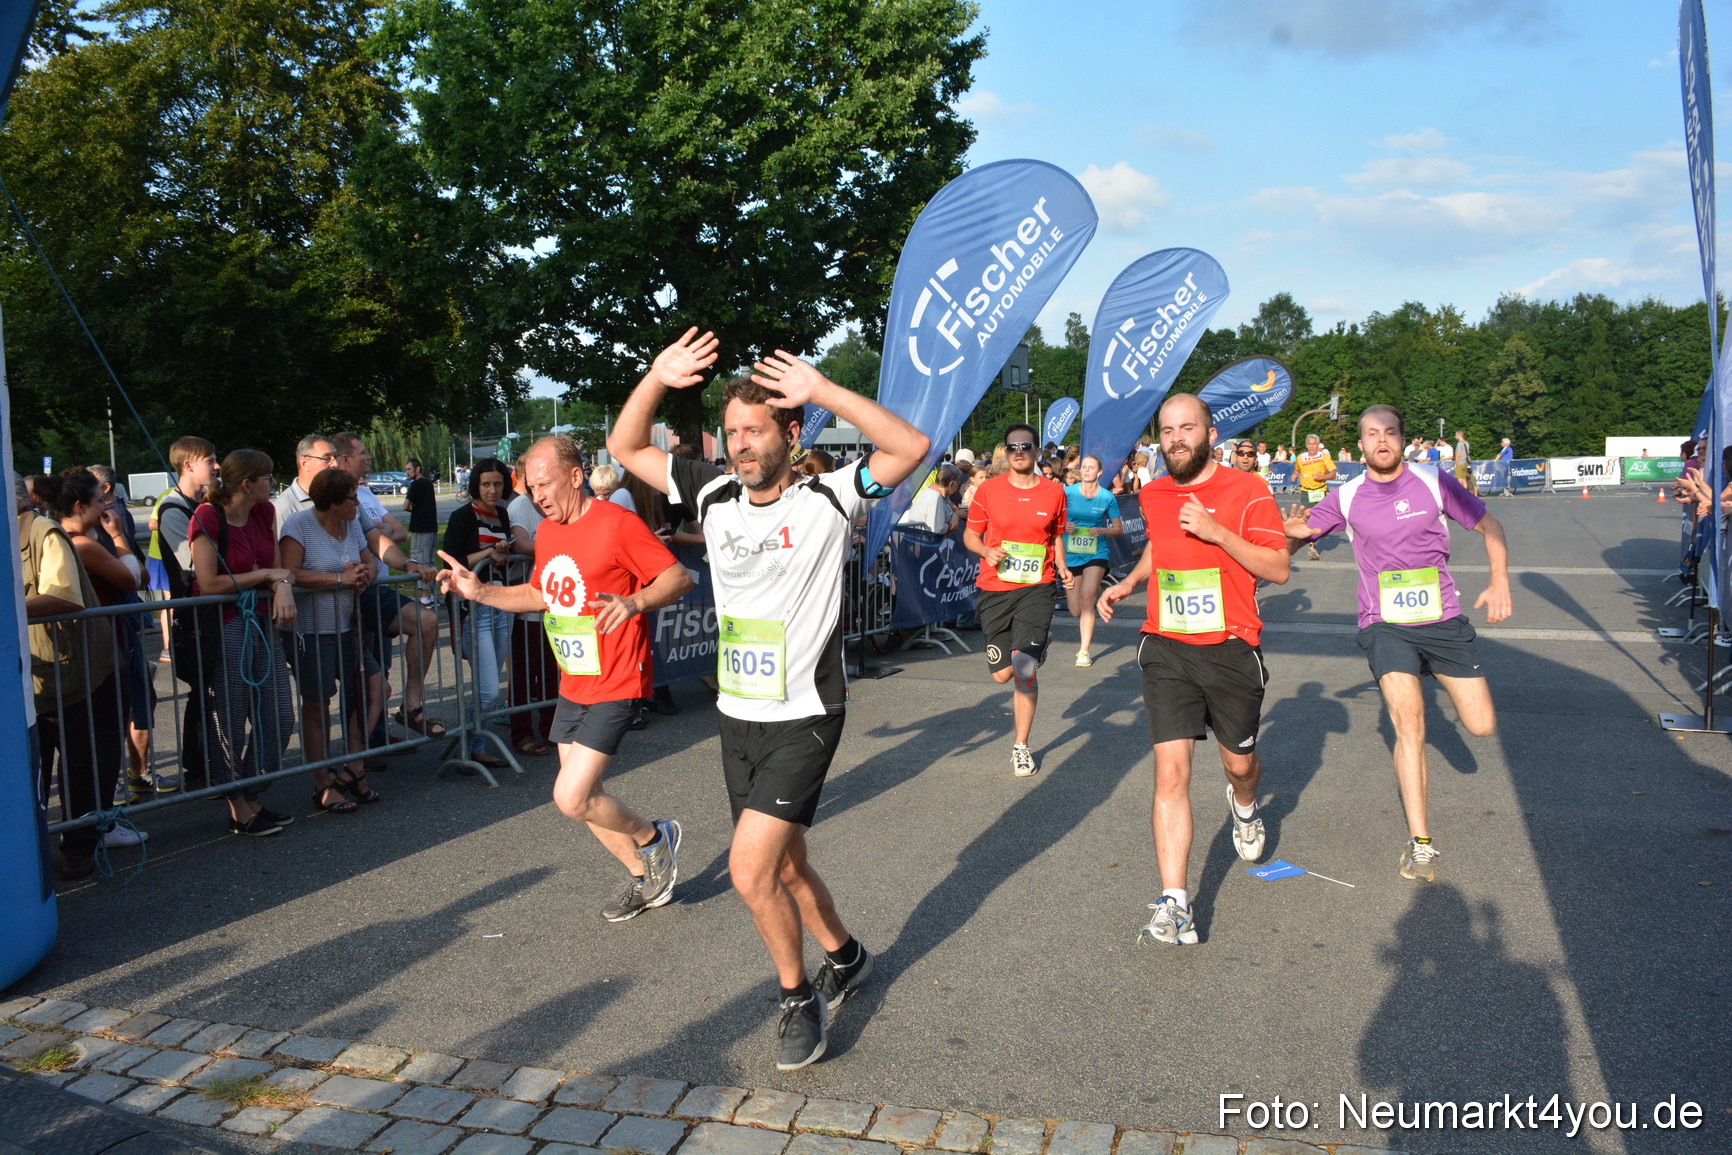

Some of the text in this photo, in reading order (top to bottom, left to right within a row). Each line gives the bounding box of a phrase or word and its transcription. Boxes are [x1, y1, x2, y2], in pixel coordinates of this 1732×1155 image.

[936, 196, 1051, 350] Fischer
[977, 226, 1064, 349] AUTOMOBILE
[1121, 271, 1198, 381] Fischer
[1149, 291, 1208, 379] AUTOMOBILE
[1052, 403, 1072, 433] Fischer
[1230, 408, 1250, 422] Druck
[1263, 388, 1288, 405] Medien
[801, 407, 825, 436] Fische
[1628, 461, 1650, 472] AOK
[1071, 537, 1095, 547] 1087
[1005, 557, 1039, 572] 1056
[546, 571, 576, 608] 48
[1165, 594, 1216, 615] 1055
[1393, 589, 1429, 608] 460
[654, 603, 718, 643] Fisc
[554, 637, 585, 658] 503
[666, 640, 719, 663] AUTOM
[723, 647, 776, 677] 1605
